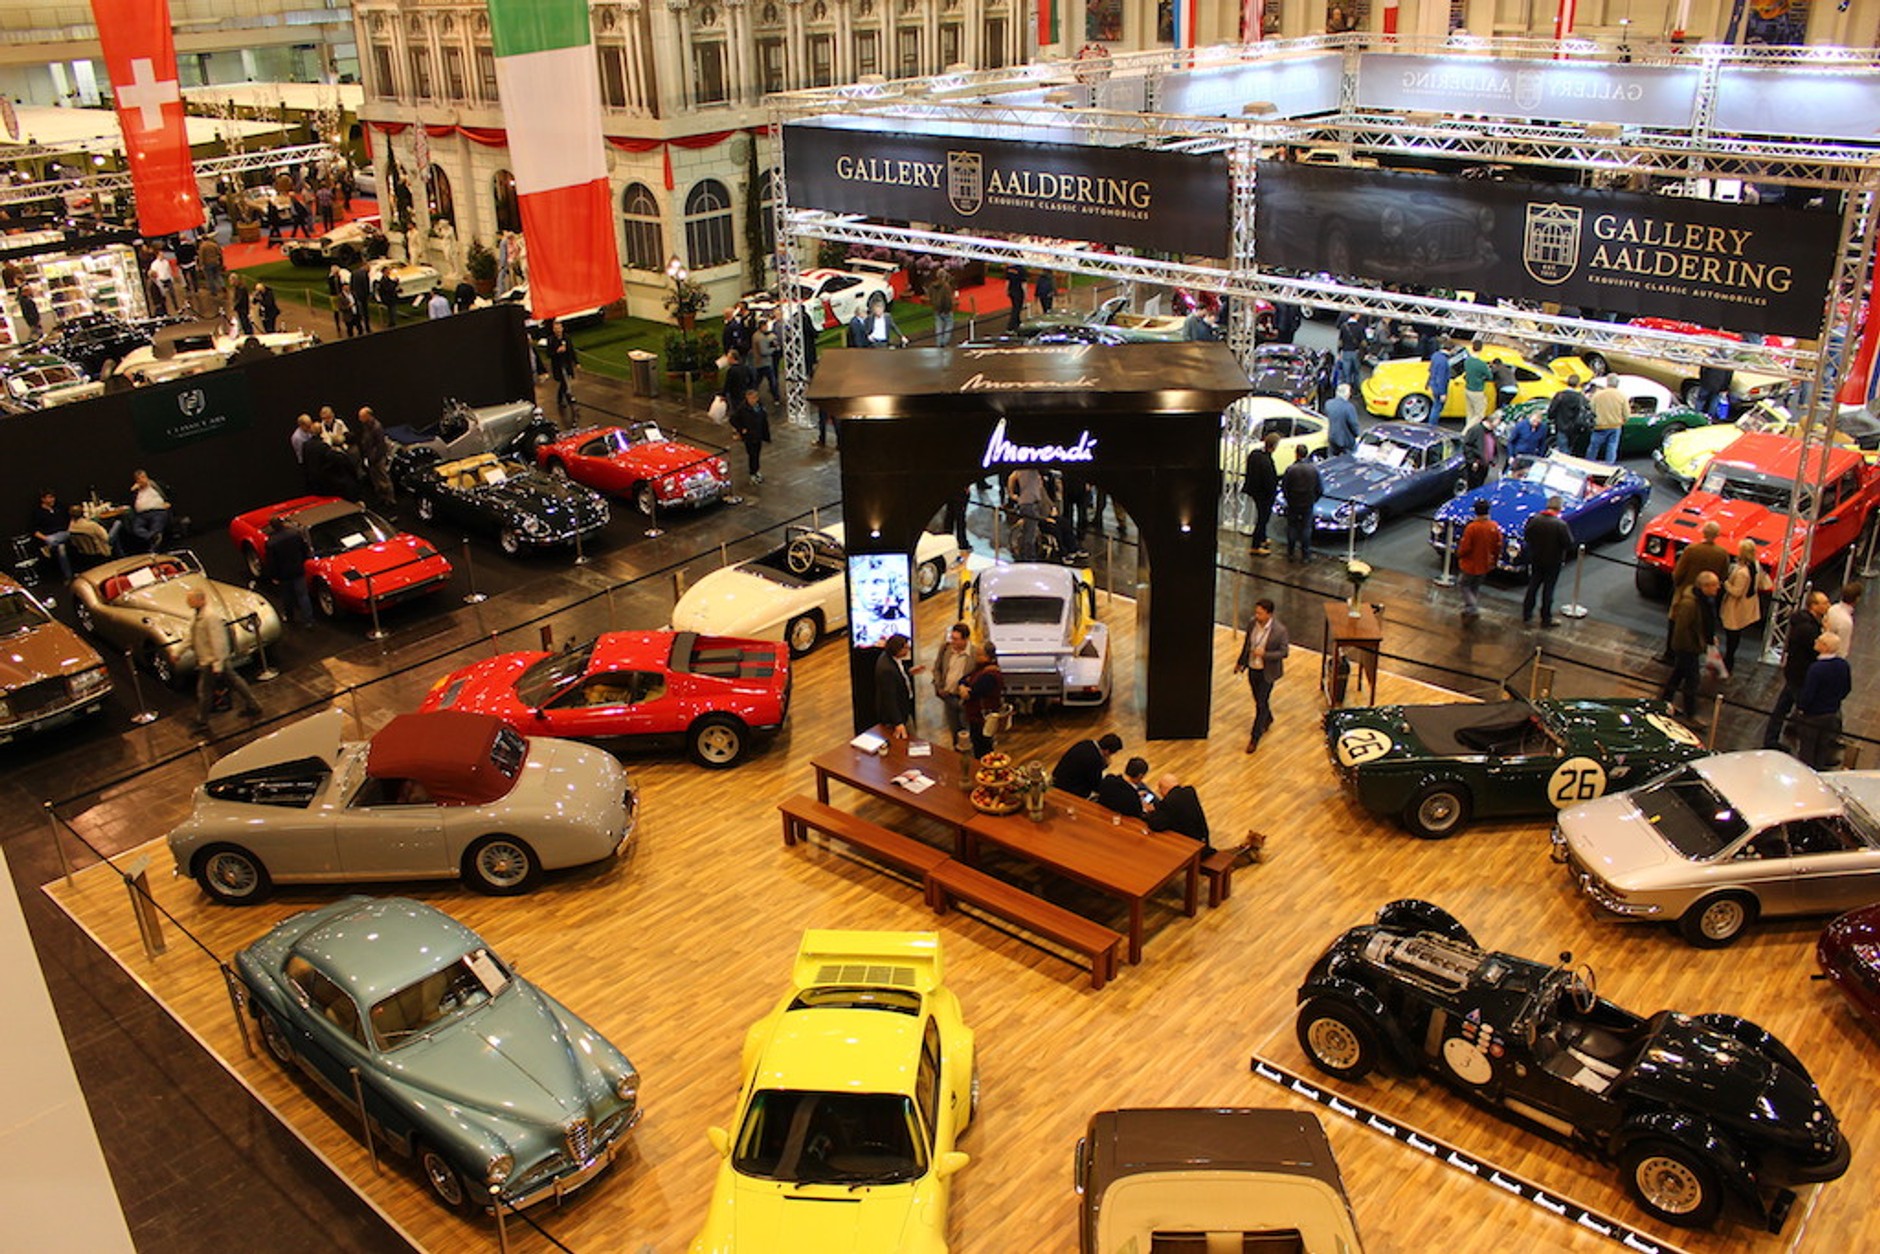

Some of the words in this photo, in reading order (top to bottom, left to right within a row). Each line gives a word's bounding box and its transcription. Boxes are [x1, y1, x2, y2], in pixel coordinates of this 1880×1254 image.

[837, 156, 944, 188] GALLERY
[987, 169, 1150, 208] AALDERING
[988, 197, 1035, 209] EXQUISITE
[1038, 201, 1077, 213] CLASSIC
[1081, 205, 1149, 220] AUTOMOBILES
[1593, 214, 1753, 256] GALLERY
[1589, 244, 1793, 293] AALDERING
[1588, 275, 1640, 289] EXQUISITE
[1644, 282, 1688, 295] CLASSIC
[1692, 289, 1768, 306] AUTOMOBILES
[981, 416, 1098, 469] Movendi
[1341, 732, 1384, 760] 26
[1557, 768, 1598, 801] 26
